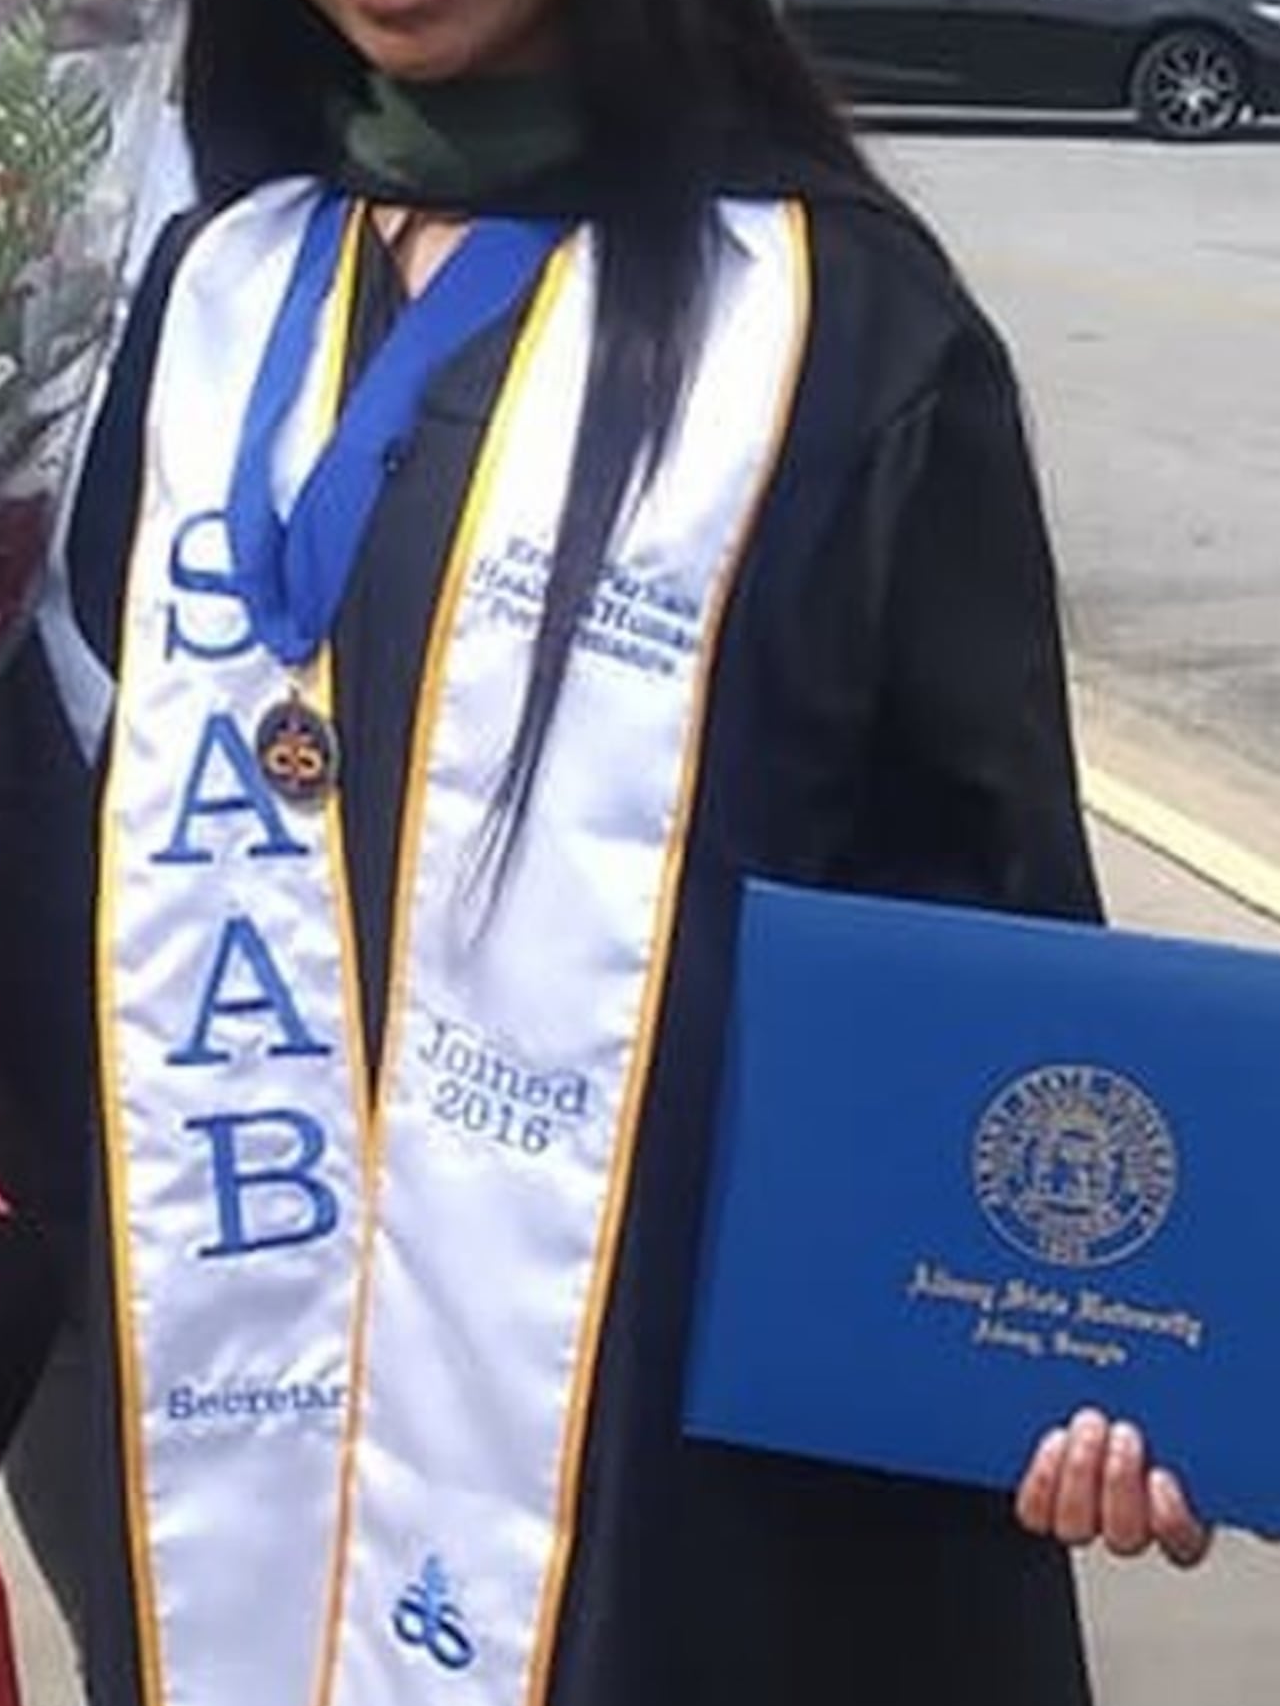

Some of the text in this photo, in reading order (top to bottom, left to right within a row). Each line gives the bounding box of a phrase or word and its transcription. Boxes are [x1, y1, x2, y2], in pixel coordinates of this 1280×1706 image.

[417, 1019, 589, 1116] Joined
[433, 1079, 552, 1155] 2016
[169, 1384, 347, 1420] Secretar
